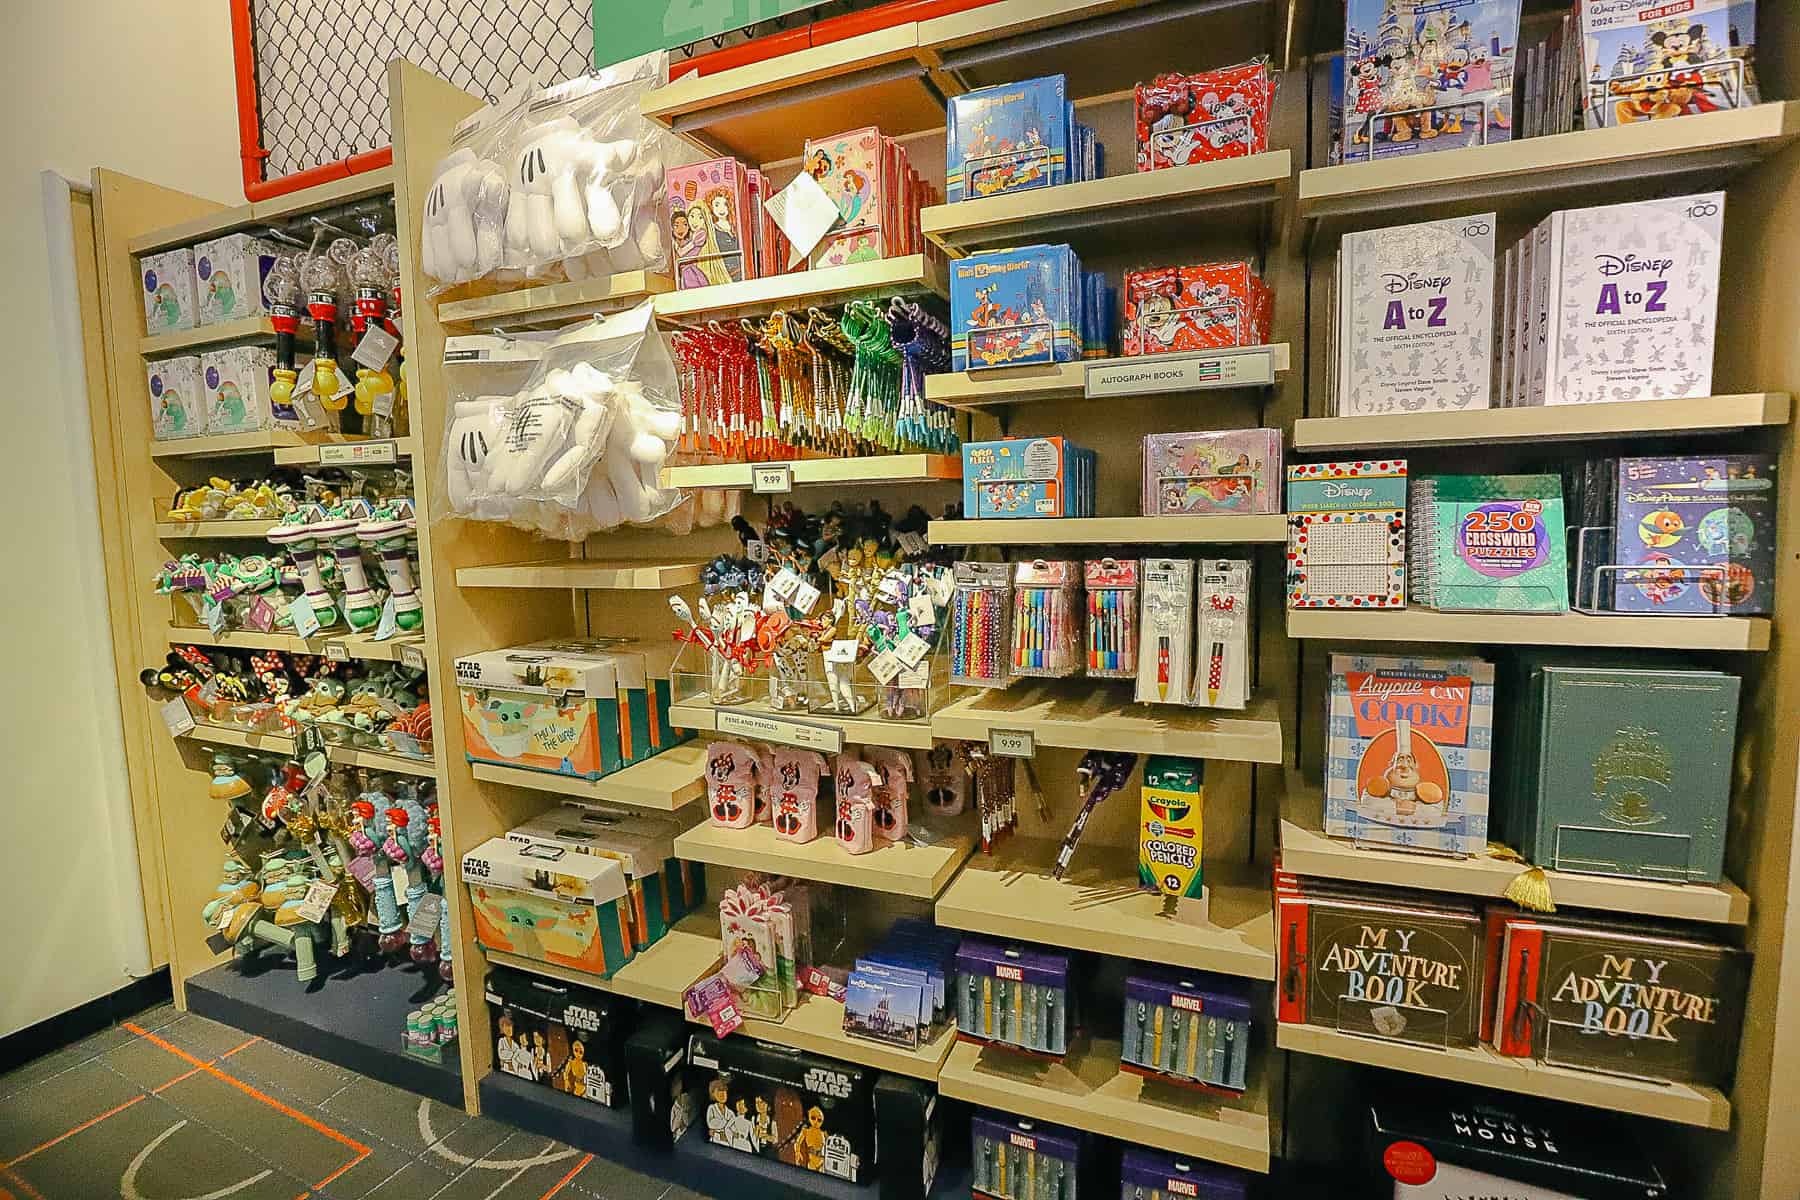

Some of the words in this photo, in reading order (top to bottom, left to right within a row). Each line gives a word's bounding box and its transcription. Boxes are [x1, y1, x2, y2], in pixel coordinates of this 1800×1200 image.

[1641, 10, 1664, 20] FOR
[1665, 3, 1692, 17] KIDS
[1591, 17, 1613, 26] 2024
[1686, 204, 1718, 218] 100
[1462, 224, 1490, 237] 100
[1594, 254, 1673, 277] Disney
[1380, 272, 1452, 295] Disney
[1596, 283, 1621, 314] A
[1624, 290, 1641, 305] to
[1645, 280, 1668, 313] Z
[1383, 300, 1406, 329] A
[1408, 307, 1425, 320] to
[1427, 297, 1447, 327] Z
[1599, 319, 1627, 328] OFFICIAL
[1628, 316, 1678, 326] ENCYCLOPEDIA
[1627, 326, 1653, 334] EDITION
[1386, 334, 1411, 342] OFFICIAL
[1413, 331, 1457, 341] ENCYCLOPEDIA
[1100, 373, 1151, 385] AUTOGRAPH
[1153, 370, 1184, 380] BOOKS
[1628, 467, 1639, 480] 5
[1320, 481, 1373, 501] Disney
[1465, 512, 1535, 532] 250
[1466, 532, 1536, 546] CROSSWORD
[1466, 546, 1536, 559] PUZZLES
[456, 662, 482, 671] STAR
[457, 670, 482, 679] WARS
[1359, 675, 1423, 700] Anyone
[1430, 685, 1465, 700] CAN
[1360, 700, 1464, 728] COOK!
[725, 716, 740, 724] PENS
[740, 718, 754, 727] AND
[754, 721, 778, 731] PENCILS
[543, 739, 558, 751] THE
[1001, 739, 1021, 748] 9.99
[1148, 776, 1159, 785] 12
[1150, 796, 1186, 807] Crayola
[1147, 841, 1196, 856] COLORED
[464, 858, 490, 869] STAR
[1151, 852, 1194, 868] PENCILS
[464, 867, 490, 877] WARS
[1167, 877, 1178, 888] 12
[996, 965, 1022, 981] MARVEL
[1320, 942, 1462, 991] ADVENTURE
[1345, 970, 1429, 1008] BOOK
[1172, 995, 1201, 1012] MARVEL
[1552, 971, 1720, 1024] ADVENTURE
[564, 1005, 600, 1022] STAR
[564, 1015, 599, 1032] WARS
[1581, 1001, 1679, 1043] BOOK
[804, 1068, 852, 1087] STAR
[805, 1078, 852, 1098] WARS
[1451, 1112, 1552, 1138] MICKEY
[1010, 1133, 1036, 1150] MARVEL
[1454, 1123, 1559, 1154] MOUSE
[1168, 1179, 1197, 1196] MARVEL
